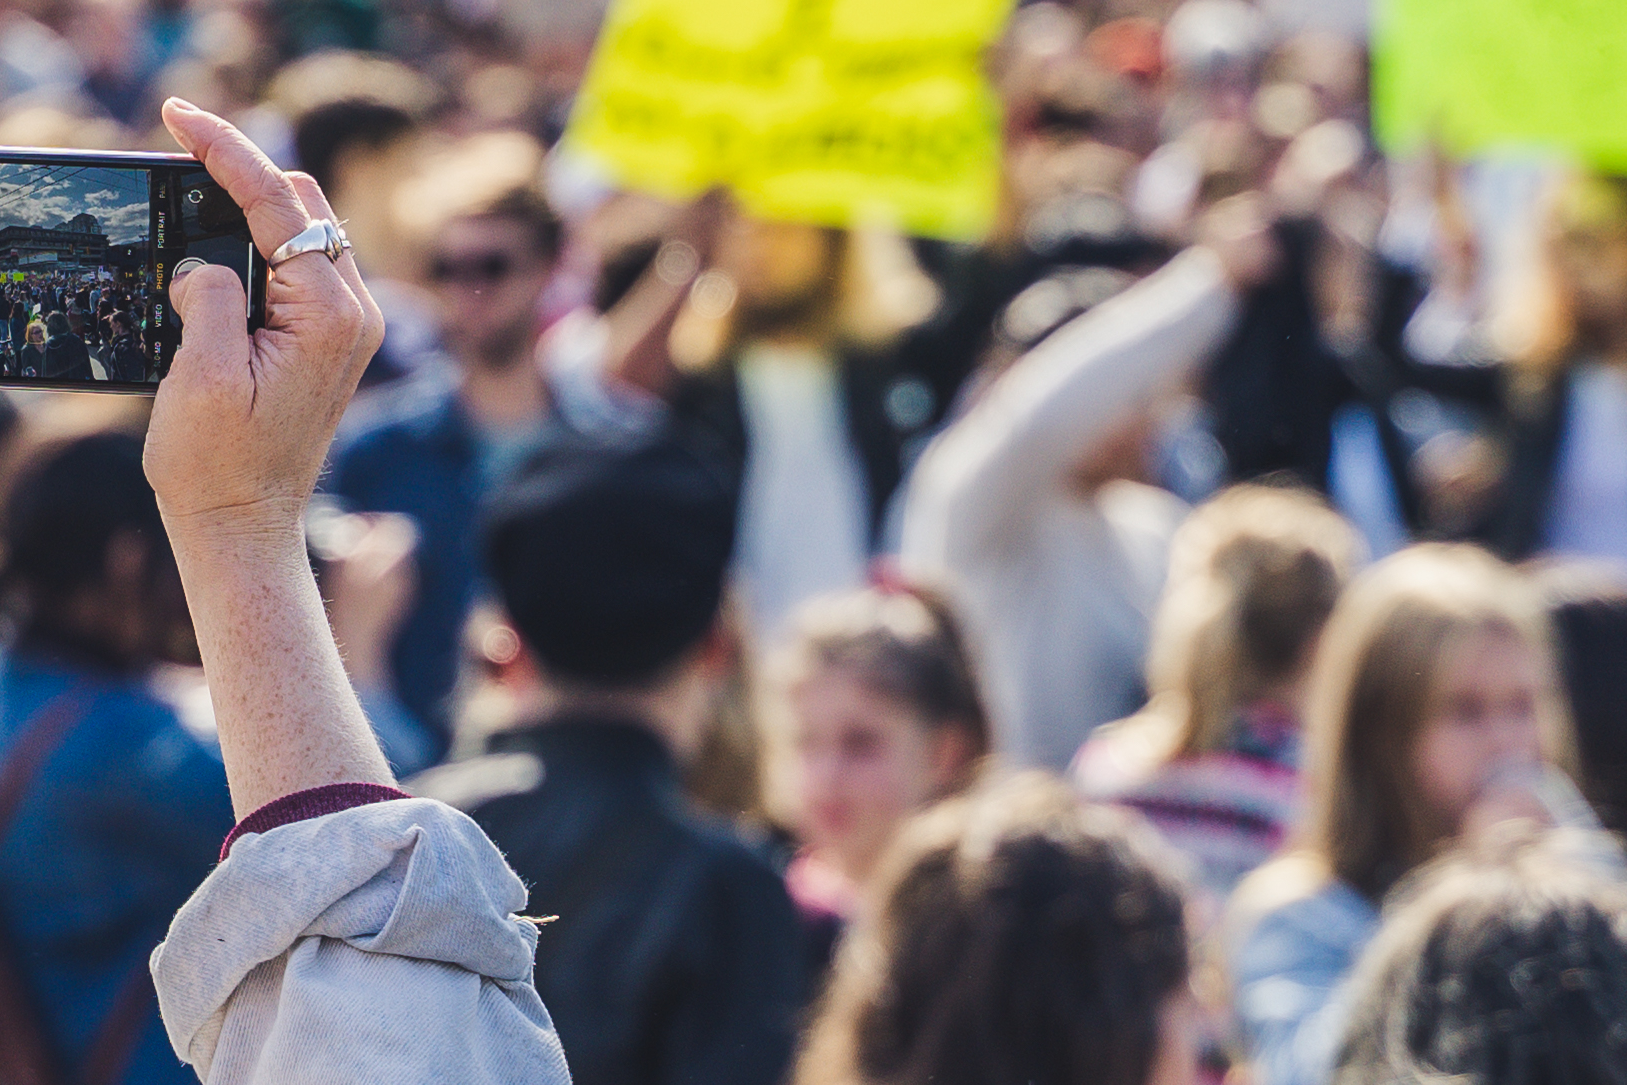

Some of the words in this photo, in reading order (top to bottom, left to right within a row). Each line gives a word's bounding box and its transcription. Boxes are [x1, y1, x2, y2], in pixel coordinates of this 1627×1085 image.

[157, 211, 166, 249] PORTRAIT
[156, 263, 164, 290] PHOTO
[155, 304, 163, 328] VIDEO
